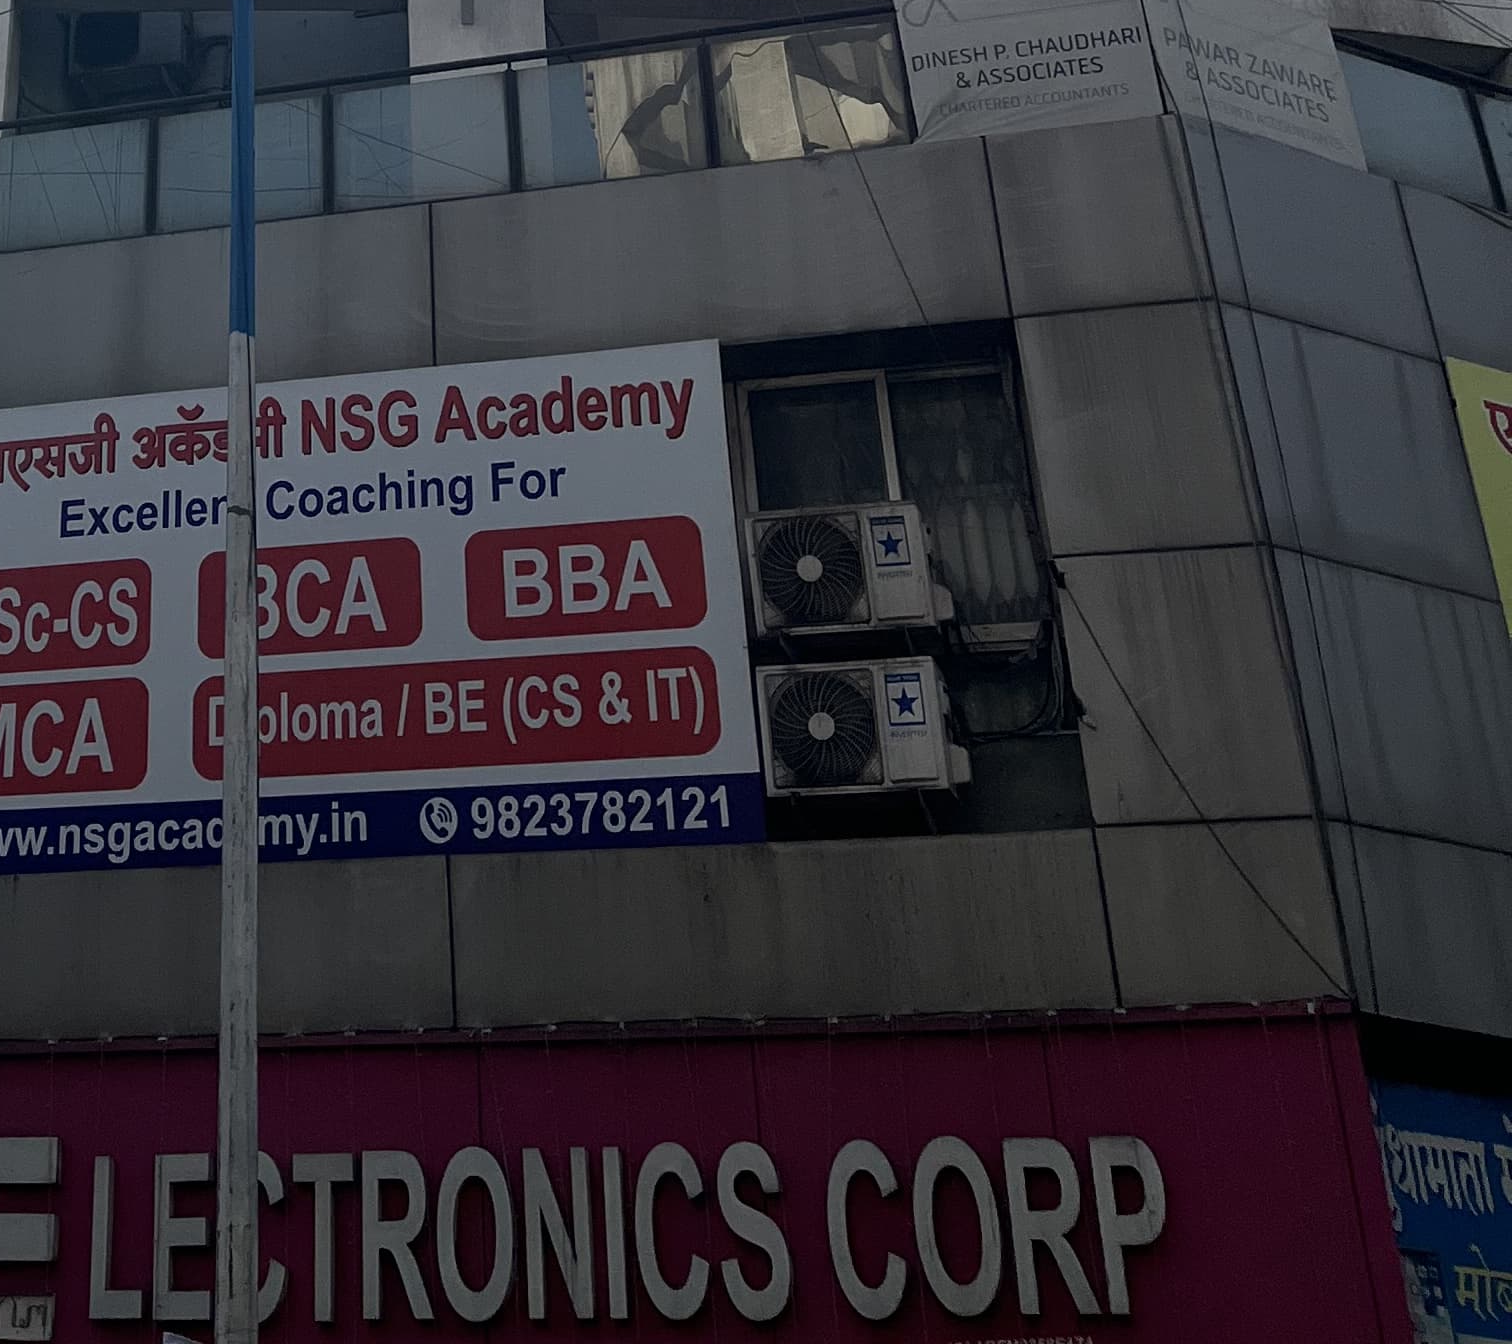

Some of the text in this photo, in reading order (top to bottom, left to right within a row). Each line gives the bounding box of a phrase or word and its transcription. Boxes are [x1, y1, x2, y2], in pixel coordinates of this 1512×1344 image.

[910, 25, 1146, 74] DINESH P. CHAUDHARI
[955, 55, 1105, 89] & ASSOCIATES
[1162, 25, 1338, 101] PAWAR ZAWARE
[937, 81, 1131, 117] CHARTERED ACCOUNTANTS
[1185, 60, 1200, 81] &
[1206, 71, 1330, 124] ASSOCIATES
[301, 389, 420, 456] NSG
[434, 375, 694, 442] Academy
[266, 470, 473, 521] Coaching
[490, 461, 567, 503] For
[502, 539, 673, 619] BBA
[396, 683, 409, 738] /
[424, 679, 488, 735] BE
[502, 673, 583, 745] (CS
[598, 670, 632, 724] &
[646, 666, 706, 735] IT)
[470, 784, 731, 840] 9823782121
[827, 1134, 1167, 1319] CORP
